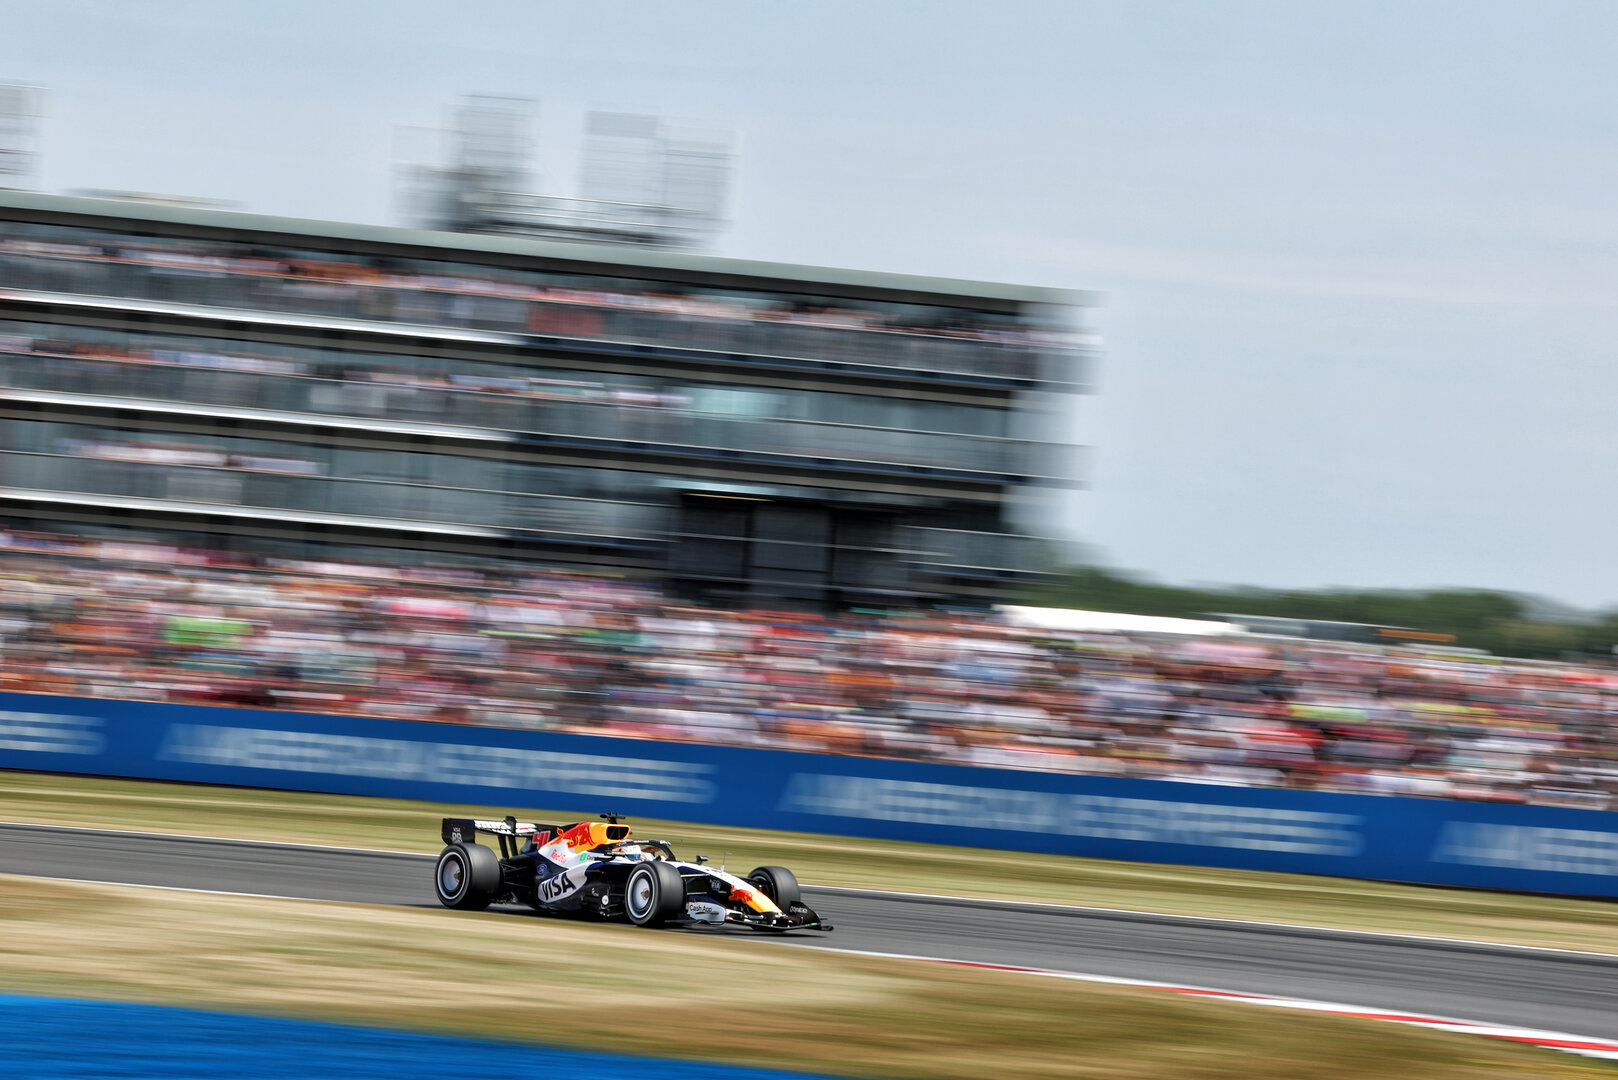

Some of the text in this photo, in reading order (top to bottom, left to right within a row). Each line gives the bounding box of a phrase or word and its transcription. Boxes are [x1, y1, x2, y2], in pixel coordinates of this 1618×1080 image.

[532, 830, 550, 848] 41
[550, 848, 560, 861] Red
[541, 872, 577, 900] VISA
[690, 904, 712, 913] Cash App
